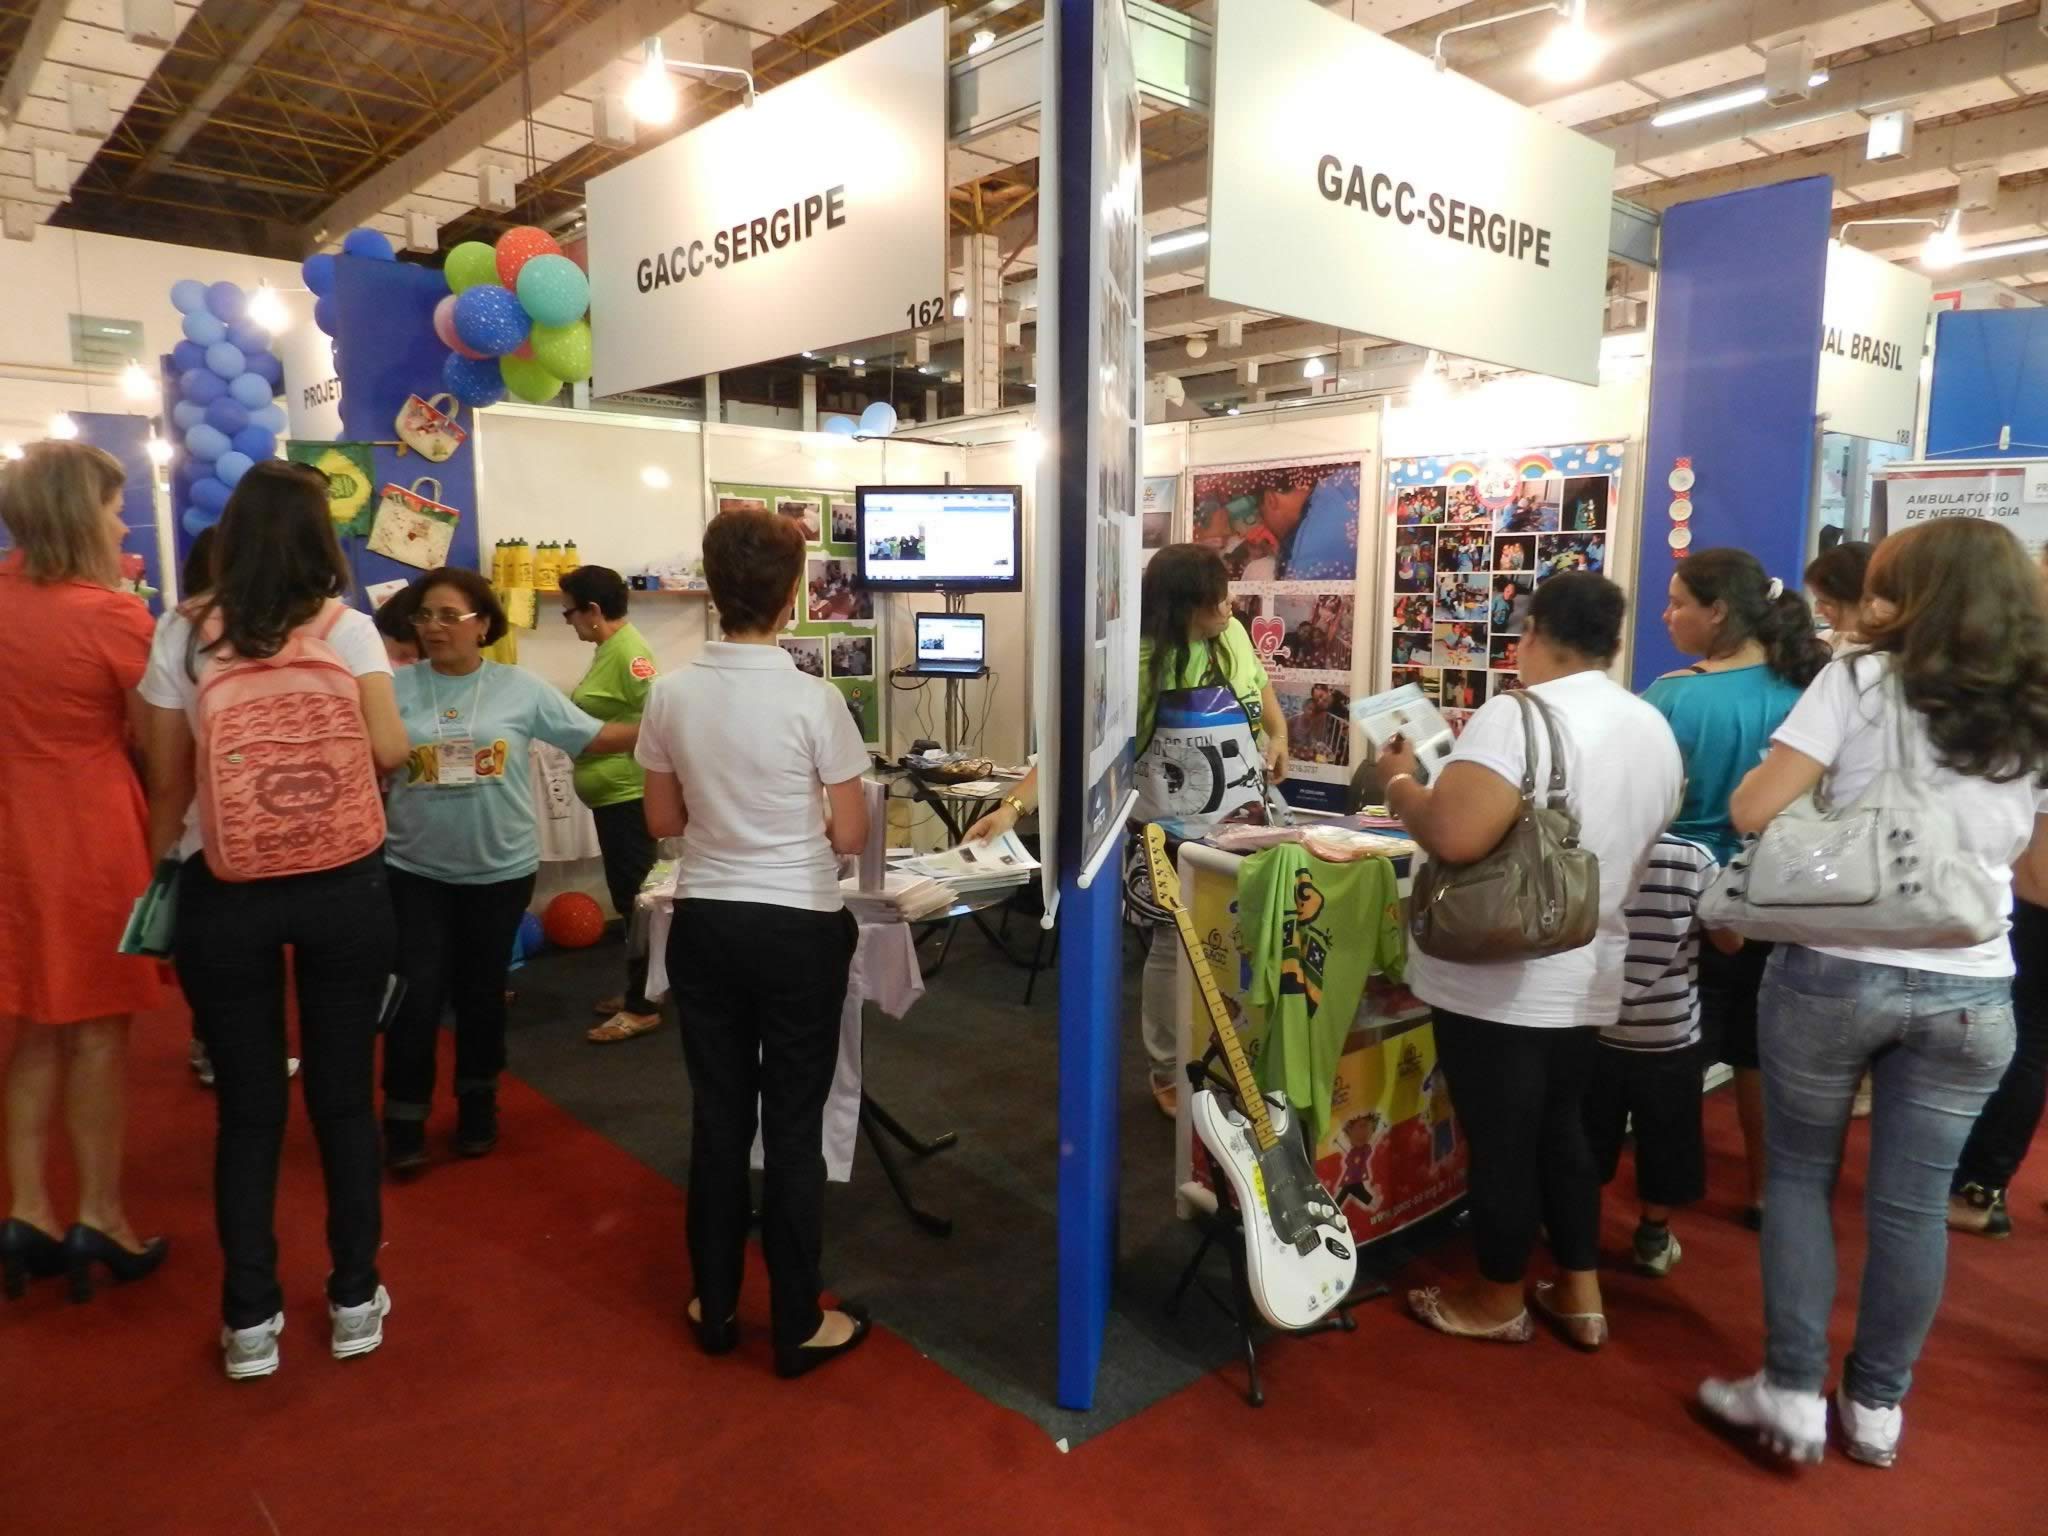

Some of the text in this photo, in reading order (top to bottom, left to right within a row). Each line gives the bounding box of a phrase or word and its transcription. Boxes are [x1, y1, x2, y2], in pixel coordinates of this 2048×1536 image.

[1317, 154, 1551, 268] GACC-SERGIPE
[637, 184, 847, 293] GACC-SERGIPE
[906, 297, 945, 328] 162
[1851, 333, 1903, 371] BRASIL
[1906, 509, 1926, 519] DE
